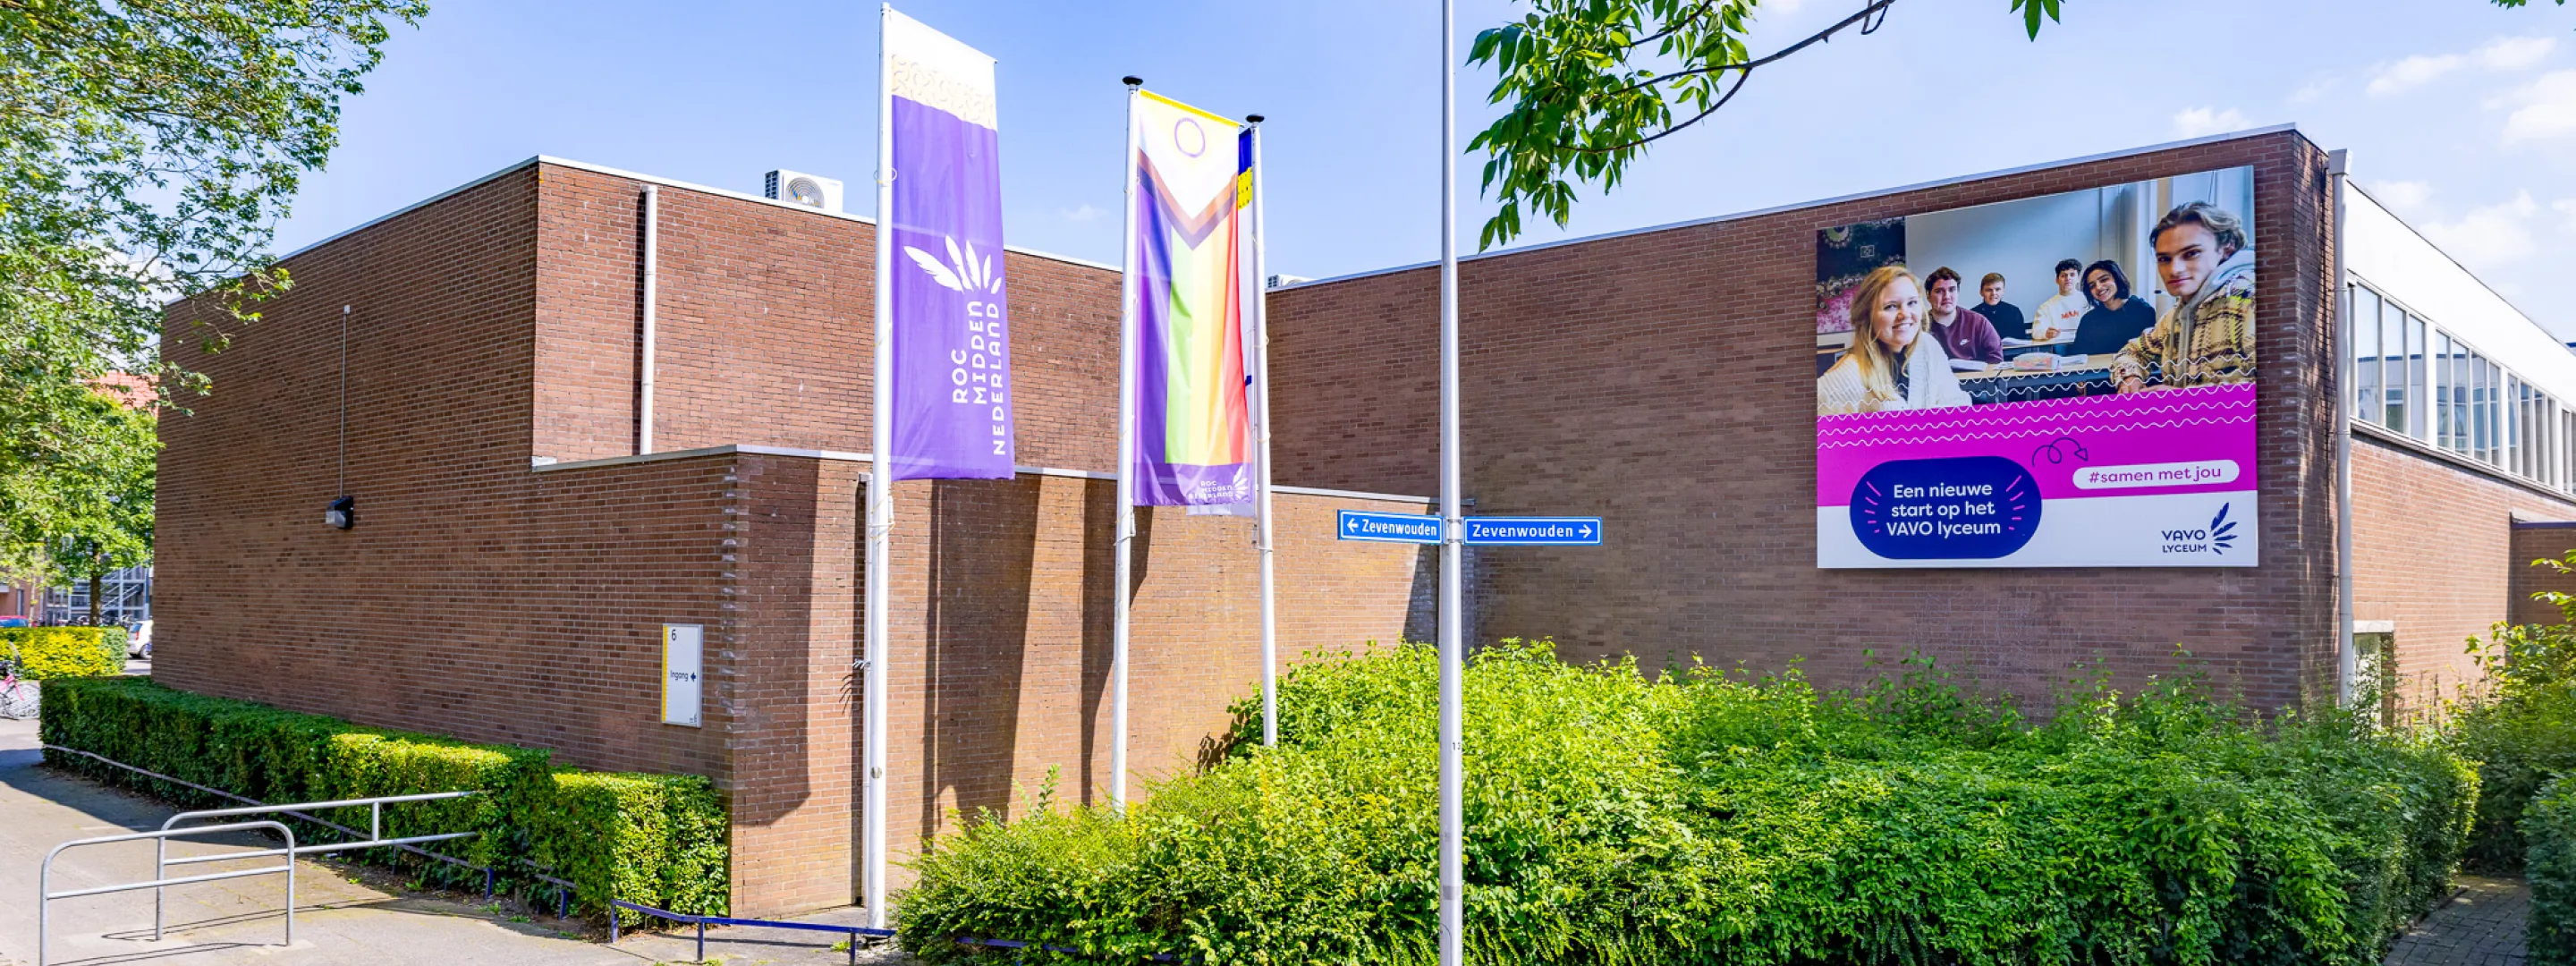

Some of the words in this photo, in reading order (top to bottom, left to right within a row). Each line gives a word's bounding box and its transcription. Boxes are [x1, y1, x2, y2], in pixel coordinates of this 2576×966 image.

[967, 301, 987, 404] MIDDEN
[951, 349, 968, 403] ROC
[987, 303, 1005, 455] NEDERLAND
[2089, 471, 2153, 484] #samen
[2158, 468, 2192, 480] met
[2193, 465, 2222, 482] jou
[1894, 484, 1925, 498] Een
[1928, 482, 1993, 497] nieuwe
[1891, 504, 1933, 517] start
[1937, 504, 1961, 520] op
[1965, 501, 1996, 515] het
[1361, 519, 1437, 537] Zevenwouden
[1472, 524, 1573, 538] Zevenwouden
[1886, 521, 1933, 536] VAVO
[1937, 521, 2001, 539] lyceum
[2161, 530, 2207, 541] VAVO
[2162, 544, 2207, 553] LYCEUM
[671, 629, 677, 641] 6
